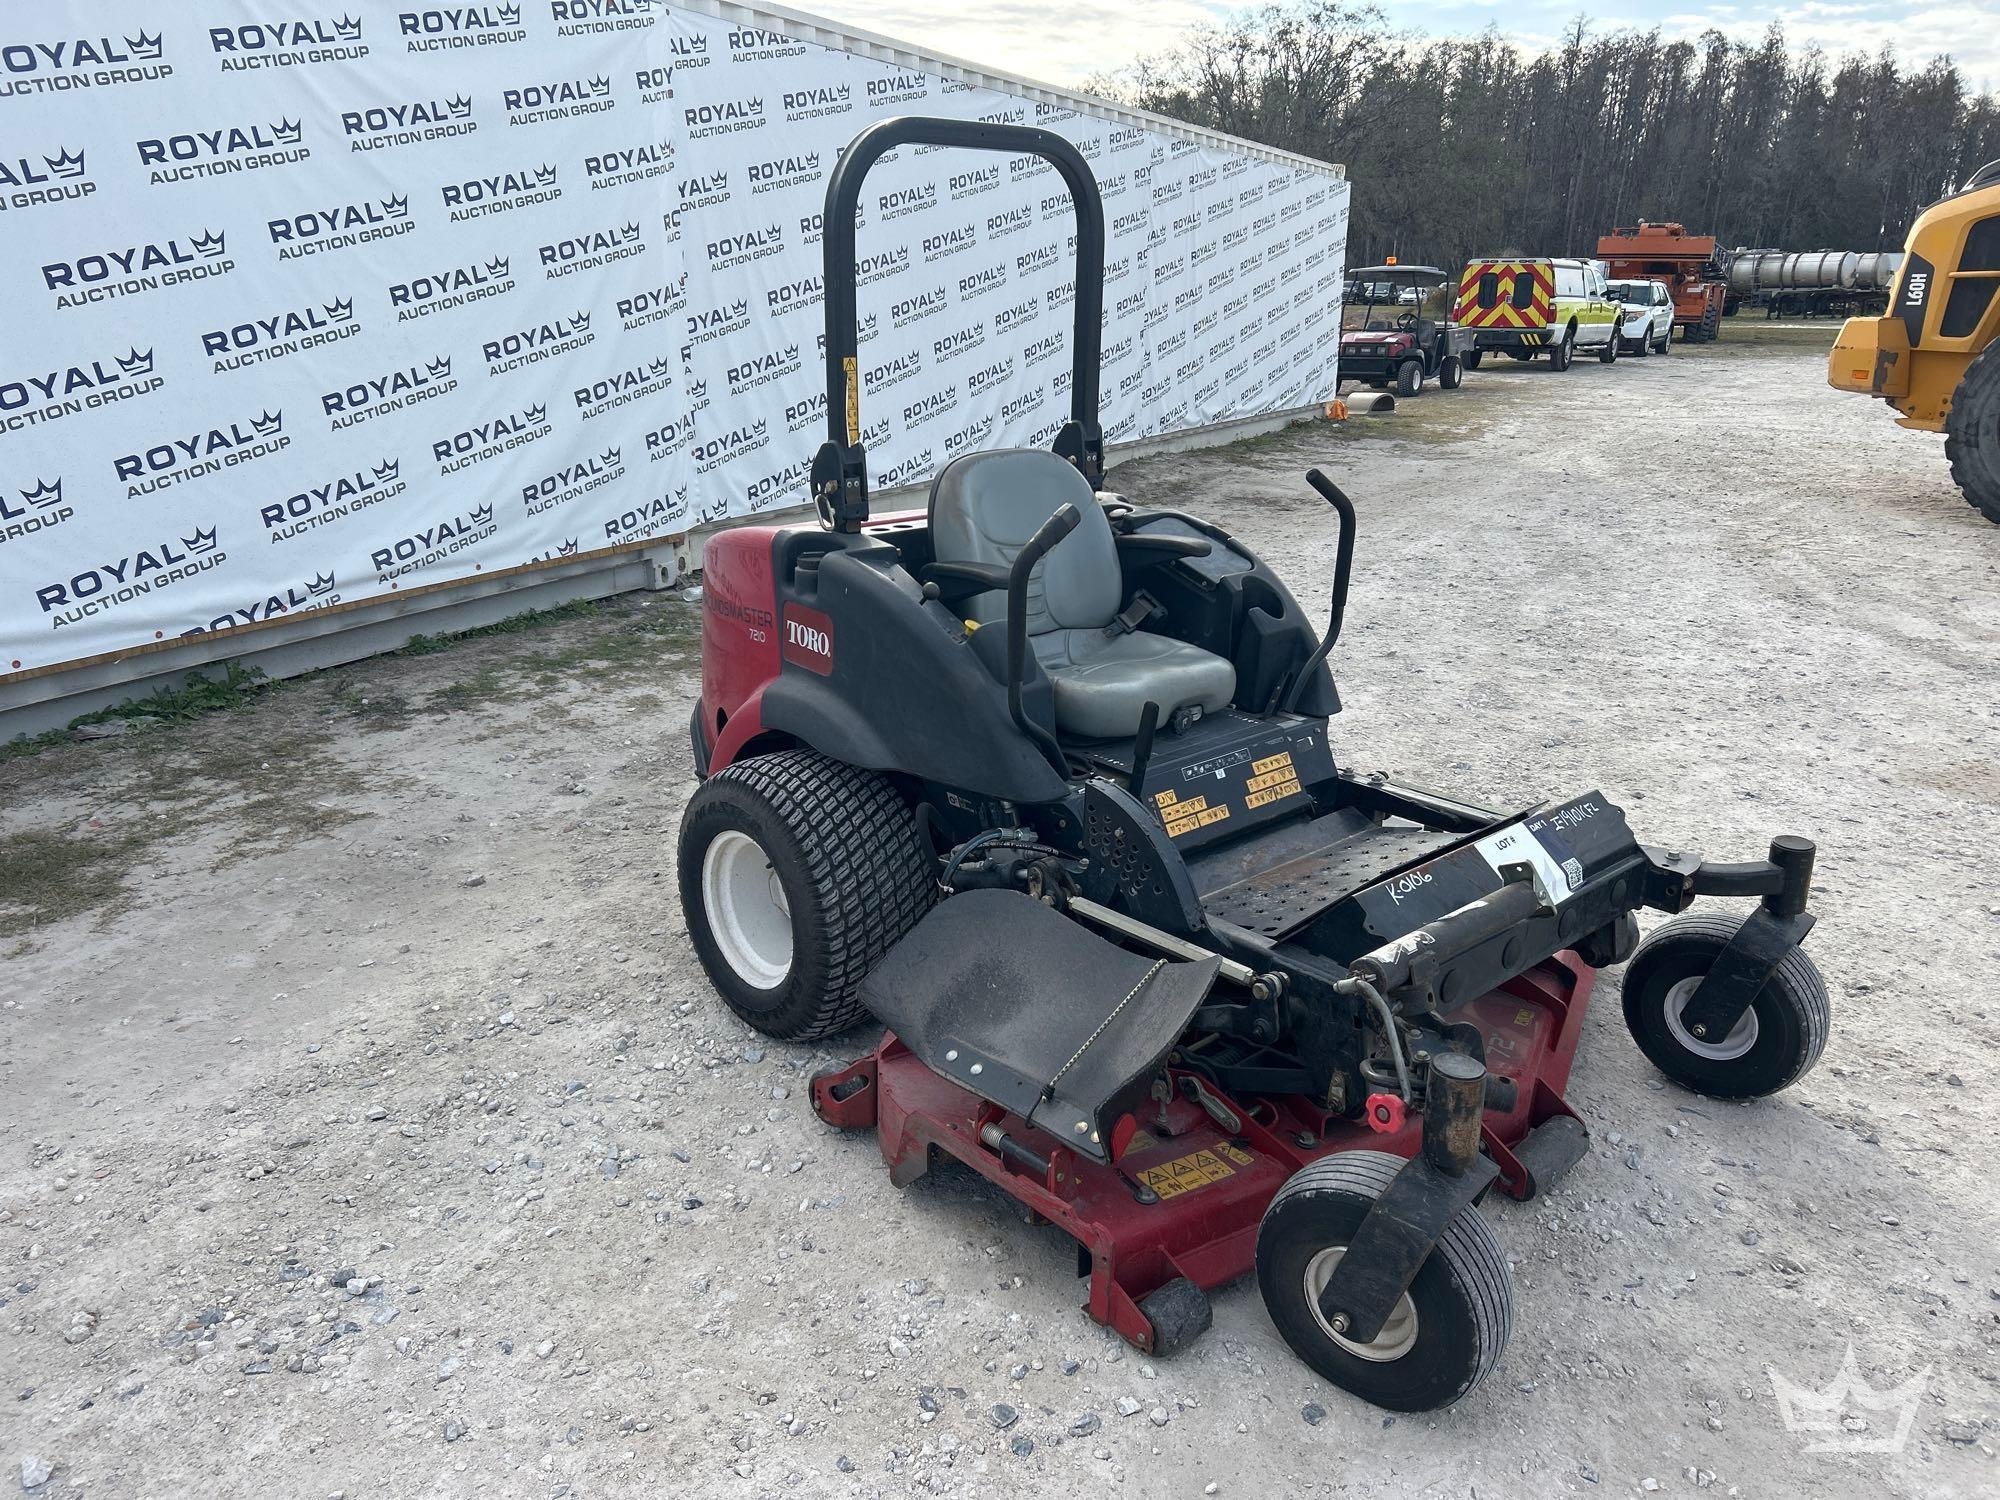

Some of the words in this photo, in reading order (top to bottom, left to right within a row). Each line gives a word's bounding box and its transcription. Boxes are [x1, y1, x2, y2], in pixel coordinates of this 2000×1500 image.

[400, 7, 499, 35] ROYAL
[552, 0, 634, 21] ROYAL
[209, 20, 335, 52] ROYAL
[408, 35, 474, 52] AUCTION
[477, 30, 526, 45] GROUP
[558, 22, 614, 37] AUCTION
[616, 17, 655, 32] GROUP
[0, 38, 128, 74] OYAL
[222, 52, 305, 71] AUCTION
[308, 46, 369, 62] GROUP
[94, 65, 173, 84] GROUP
[867, 75, 913, 96] ROYAL
[504, 81, 589, 110] ROYAL
[783, 87, 837, 110] ROYAL
[870, 94, 900, 107] AUCTION
[903, 90, 926, 101] GROUP
[341, 101, 447, 134] ROYAL
[511, 108, 568, 126] AUCTION
[572, 100, 614, 115] GROUP
[684, 101, 748, 126] ROYAL
[787, 108, 823, 122] AUCTION
[825, 103, 852, 115] GROUP
[351, 131, 421, 152] AUCTION
[424, 122, 476, 139] GROUP
[689, 123, 731, 140] AUCTION
[733, 118, 765, 131] GROUP
[138, 126, 274, 165] ROYAL
[586, 145, 661, 175] ROYAL
[152, 159, 242, 185] AUCTION
[244, 148, 310, 169] GROUP
[593, 170, 642, 190] AUCTION
[645, 162, 675, 177] GROUP
[748, 156, 805, 182] ROYAL
[950, 169, 988, 190] ROYAL
[442, 171, 535, 206] ROYAL
[752, 177, 790, 194] AUCTION
[792, 171, 821, 185] GROUP
[952, 187, 977, 201] AUCTION
[979, 181, 999, 192] GROUP
[1152, 182, 1175, 199] ROYAL
[451, 199, 512, 222] AUCTION
[515, 189, 561, 207] GROUP
[879, 186, 923, 210] ROYAL
[882, 206, 911, 221] AUCTION
[914, 199, 936, 212] GROUP
[1208, 199, 1227, 215] ROYAL
[268, 202, 384, 243] ROYAL
[987, 209, 1021, 231] ROYAL
[989, 226, 1012, 240] AUCTION
[1013, 219, 1031, 231] GROUP
[280, 234, 356, 261] AUCTION
[358, 221, 415, 242] GROUP
[541, 230, 620, 265] ROYAL
[706, 230, 767, 260] ROYAL
[923, 228, 963, 253] ROYAL
[926, 247, 952, 263] AUCTION
[955, 239, 975, 252] GROUP
[42, 241, 192, 290] ROYAL
[547, 256, 600, 279] AUCTION
[604, 244, 643, 262] GROUP
[710, 252, 751, 272] AUCTION
[753, 243, 783, 259] GROUP
[1017, 246, 1049, 269] ROYAL
[1018, 263, 1040, 278] AUCTION
[1041, 256, 1057, 268] GROUP
[1155, 259, 1177, 278] ROYAL
[1240, 254, 1257, 271] ROYAL
[58, 276, 157, 309] AUCTION
[162, 260, 234, 285] GROUP
[389, 265, 487, 306] ROYAL
[959, 268, 996, 292] ROYAL
[961, 286, 986, 302] AUCTION
[988, 277, 1006, 291] GROUP
[1905, 273, 1928, 305] L60H
[398, 294, 464, 322] AUCTION
[466, 280, 515, 302] GROUP
[891, 292, 934, 319] ROYAL
[894, 311, 922, 329] AUCTION
[924, 302, 946, 316] GROUP
[202, 308, 327, 356] ROYAL
[483, 321, 569, 362] ROYAL
[934, 328, 973, 355] ROYAL
[1157, 333, 1179, 354] ROYAL
[215, 341, 297, 374] AUCTION
[300, 324, 360, 349] GROUP
[491, 349, 548, 376] AUCTION
[552, 333, 594, 355] GROUP
[937, 346, 962, 364] AUCTION
[964, 336, 984, 351] GROUP
[1023, 335, 1055, 360] ROYAL
[1025, 352, 1046, 368] AUCTION
[1047, 343, 1063, 356] GROUP
[1210, 338, 1228, 357] ROYAL
[727, 350, 785, 385] ROYAL
[731, 373, 770, 396] AUCTION
[772, 361, 801, 379] GROUP
[864, 356, 908, 386] ROYAL
[867, 376, 897, 396] AUCTION
[898, 365, 920, 381] GROUP
[322, 367, 428, 415] ROYAL
[575, 367, 650, 407] ROYAL
[582, 393, 631, 420] AUCTION
[633, 377, 671, 398] GROUP
[332, 398, 402, 431] AUCTION
[405, 379, 457, 405] GROUP
[904, 391, 944, 421] ROYAL
[906, 411, 933, 431] AUCTION
[936, 399, 956, 415] GROUP
[116, 423, 252, 481] ROYAL
[433, 414, 525, 461] ROYAL
[442, 443, 502, 475] AUCTION
[506, 425, 551, 449] GROUP
[129, 458, 219, 499] AUCTION
[225, 436, 290, 466] GROUP
[521, 458, 602, 504] ROYAL
[260, 472, 375, 528] ROYAL
[528, 485, 581, 517] AUCTION
[585, 467, 624, 491] GROUP
[272, 505, 348, 543] AUCTION
[350, 482, 406, 511] GROUP
[372, 517, 471, 571] ROYAL
[379, 547, 448, 584] AUCTION
[448, 524, 497, 553] GROUP
[37, 543, 184, 612] ROYAL
[53, 581, 150, 629] AUCTION
[154, 552, 225, 588] GROUP
[749, 628, 766, 643] 7210
[1529, 820, 1543, 832] DAY
[1495, 837, 1511, 851] LOT
[1385, 871, 1433, 906] K-0106
